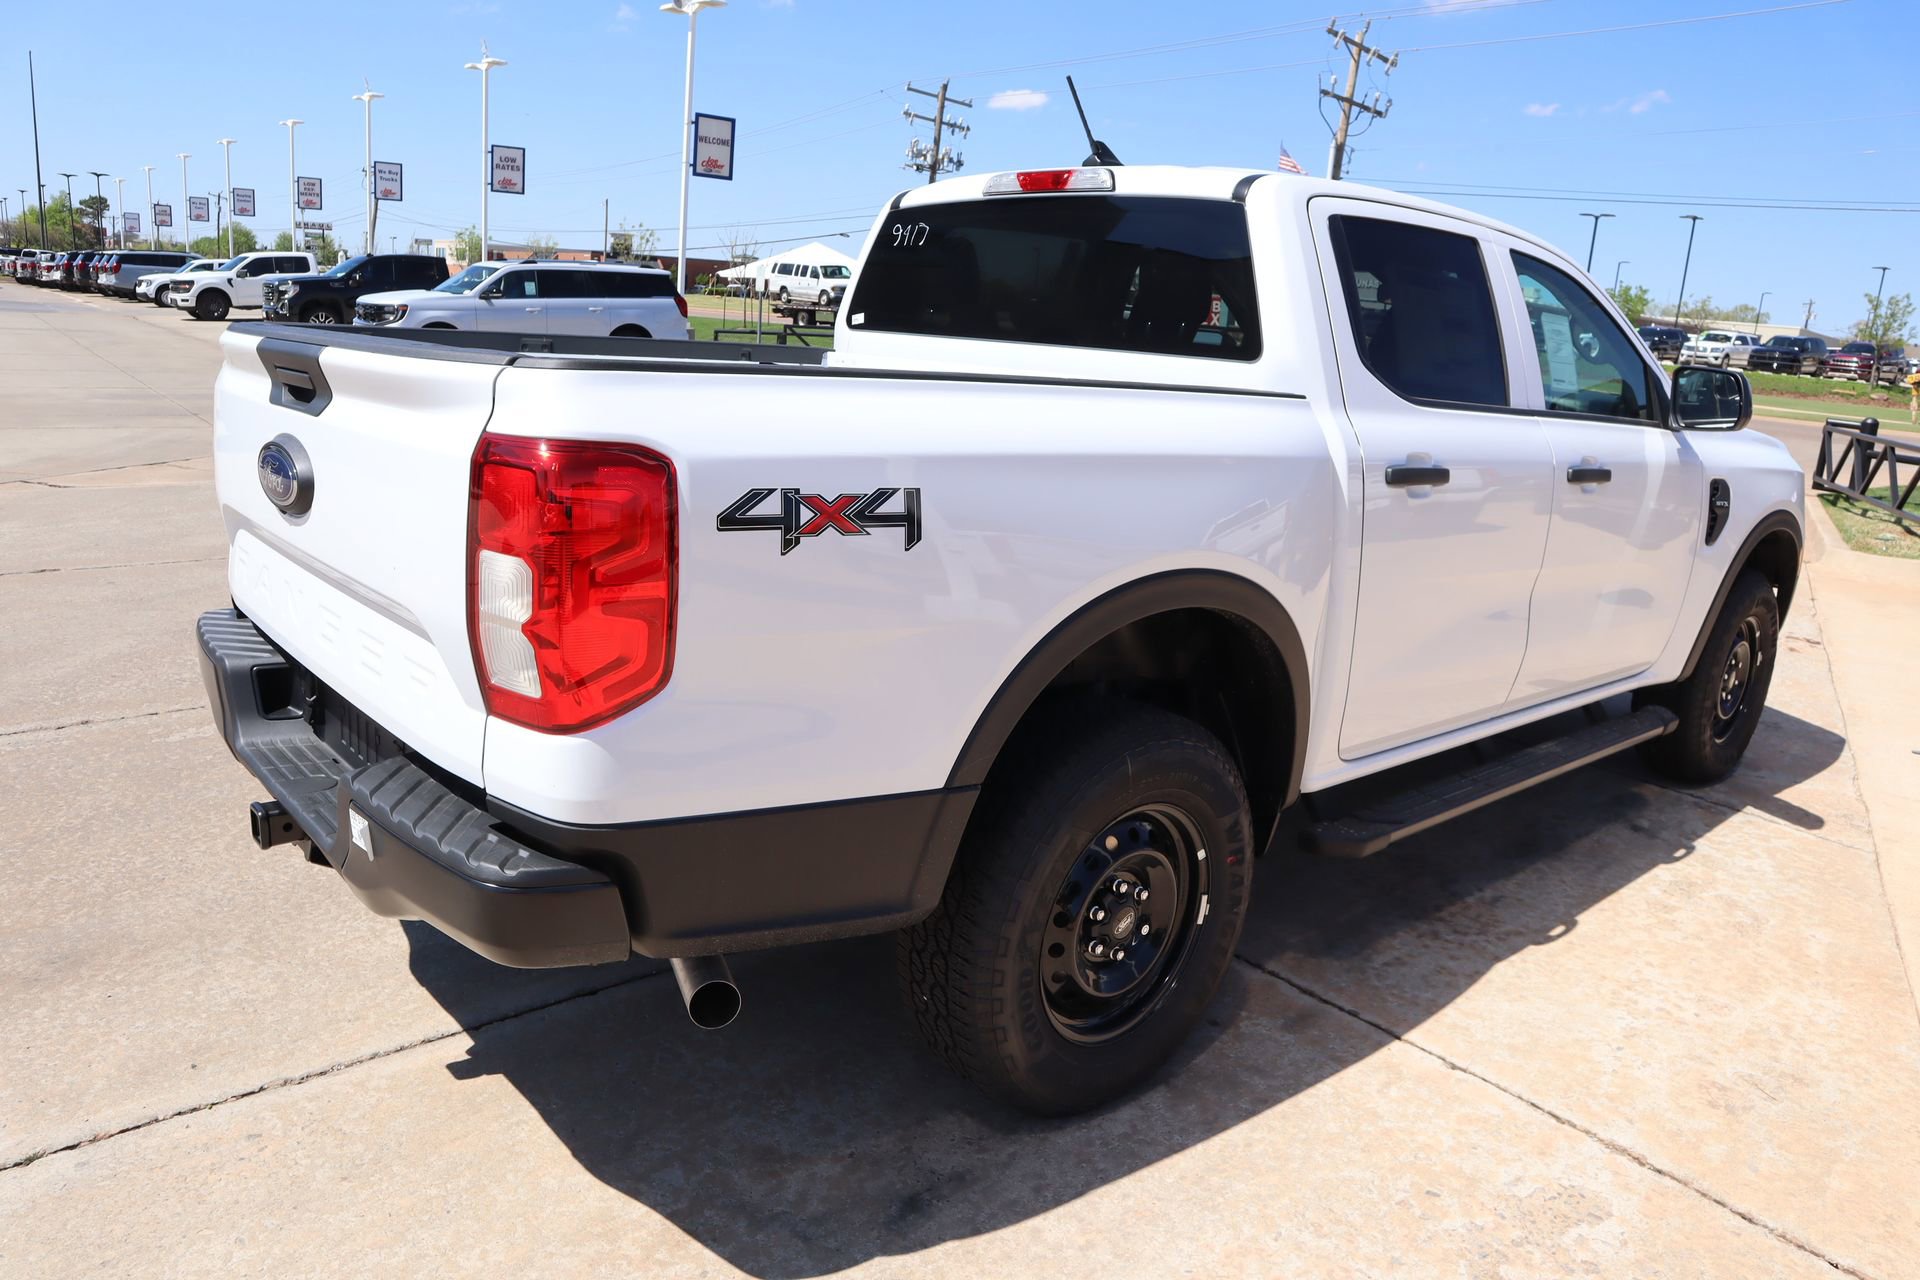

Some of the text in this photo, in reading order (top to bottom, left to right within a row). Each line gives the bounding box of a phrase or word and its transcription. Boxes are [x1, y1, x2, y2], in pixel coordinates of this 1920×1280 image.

[698, 135, 731, 148] WELCOME
[499, 155, 517, 164] LOW
[495, 163, 521, 172] RATES
